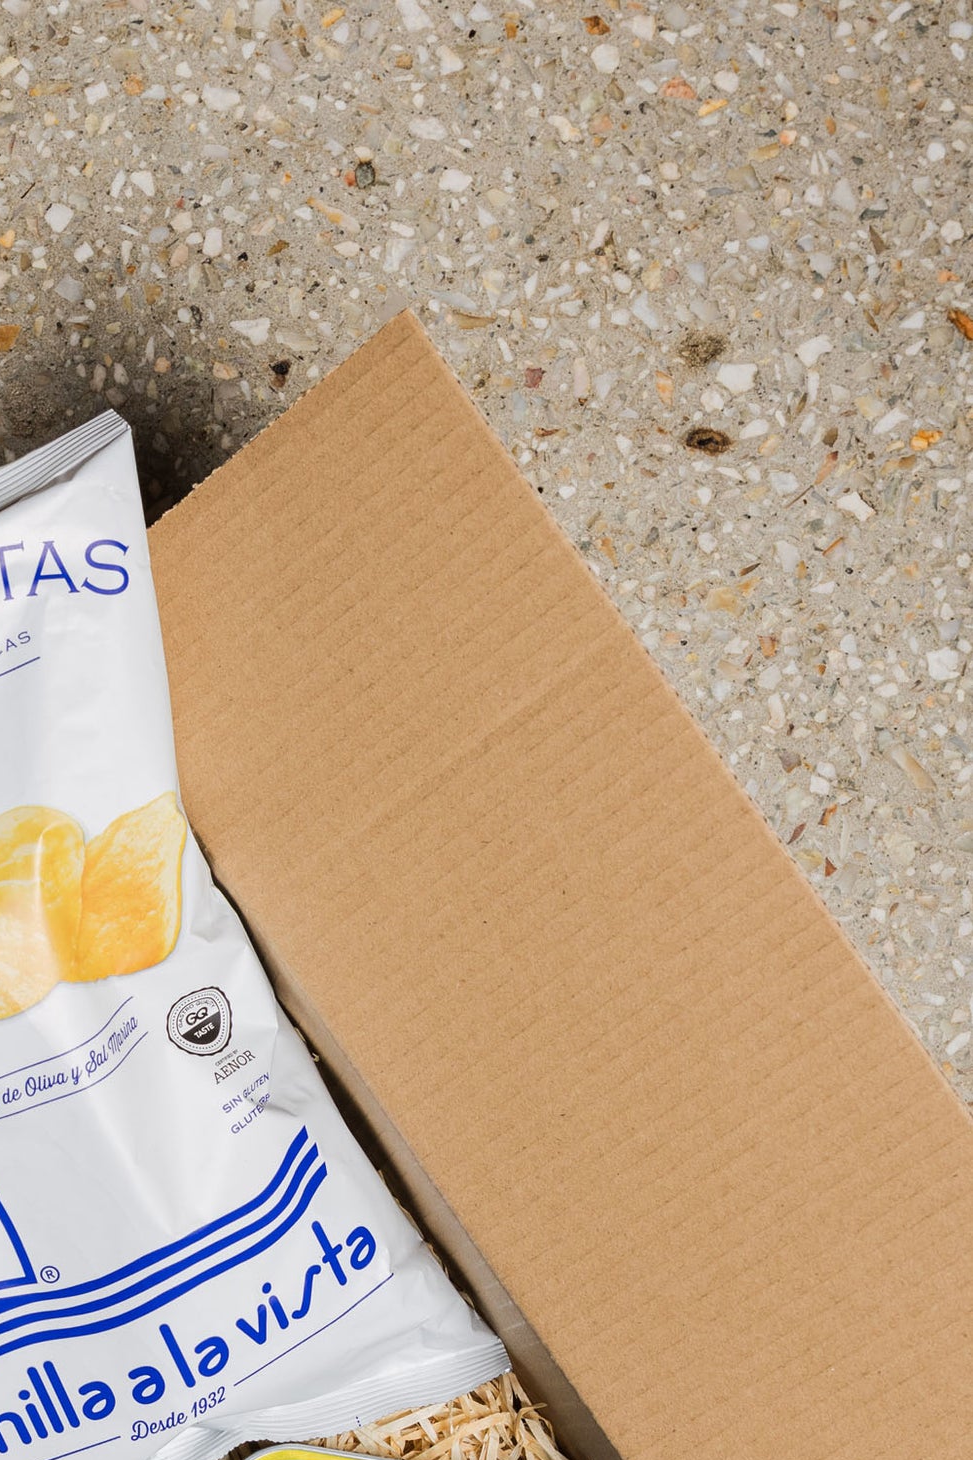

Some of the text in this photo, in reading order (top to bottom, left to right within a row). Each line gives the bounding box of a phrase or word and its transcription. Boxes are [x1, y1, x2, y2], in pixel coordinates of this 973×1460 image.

[186, 1007, 208, 1025] GQ
[194, 1022, 215, 1038] TASTE
[2, 1085, 22, 1105] de
[26, 1068, 68, 1098] Oliva
[71, 1067, 81, 1086] y
[85, 1046, 108, 1078] Sal
[214, 1050, 256, 1084] AENOR
[223, 1094, 243, 1113] SIN
[243, 1072, 270, 1099] GLUTEN
[128, 1365, 166, 1405] a
[159, 1324, 228, 1389] la
[236, 1220, 377, 1345] vista
[131, 1386, 228, 1442] Desde 1932
